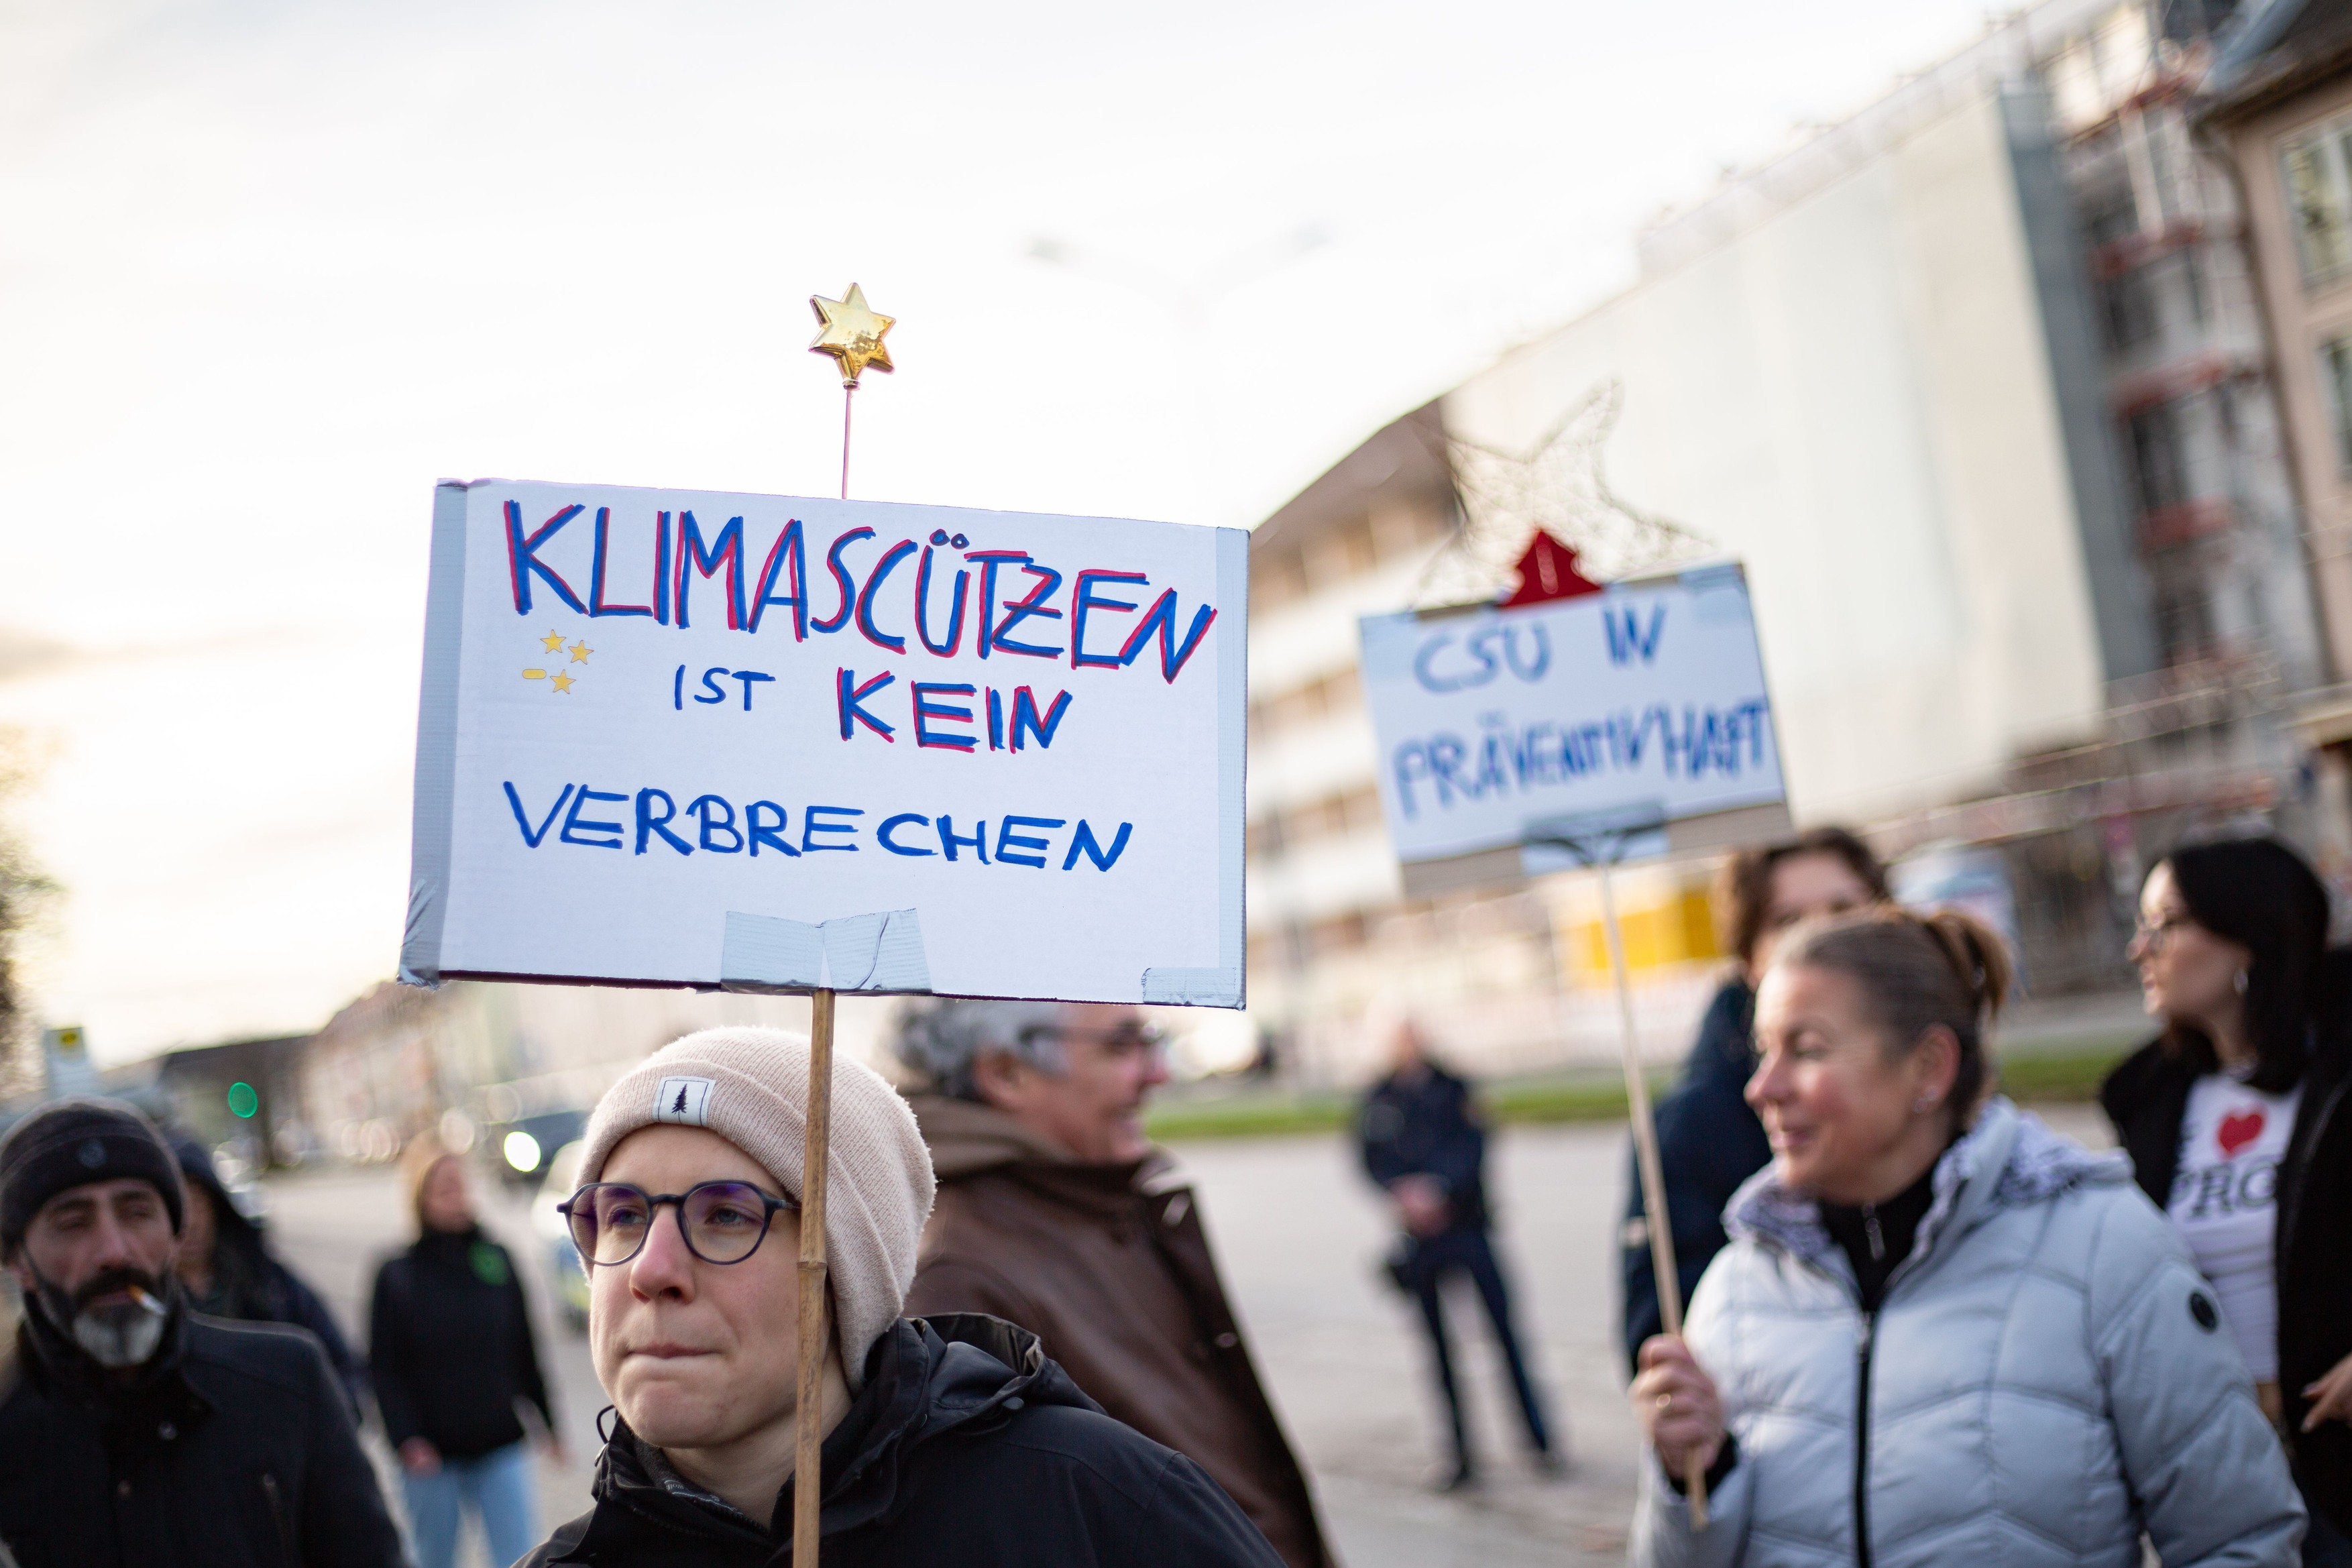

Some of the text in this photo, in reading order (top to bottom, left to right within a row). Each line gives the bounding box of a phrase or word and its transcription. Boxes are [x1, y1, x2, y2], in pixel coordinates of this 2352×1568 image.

[503, 499, 1218, 685] KLIMASCÜTZEN
[1412, 602, 1667, 695] CSU IN
[673, 664, 1074, 754] IST KEIN
[503, 780, 1134, 873] VERBRECHEN
